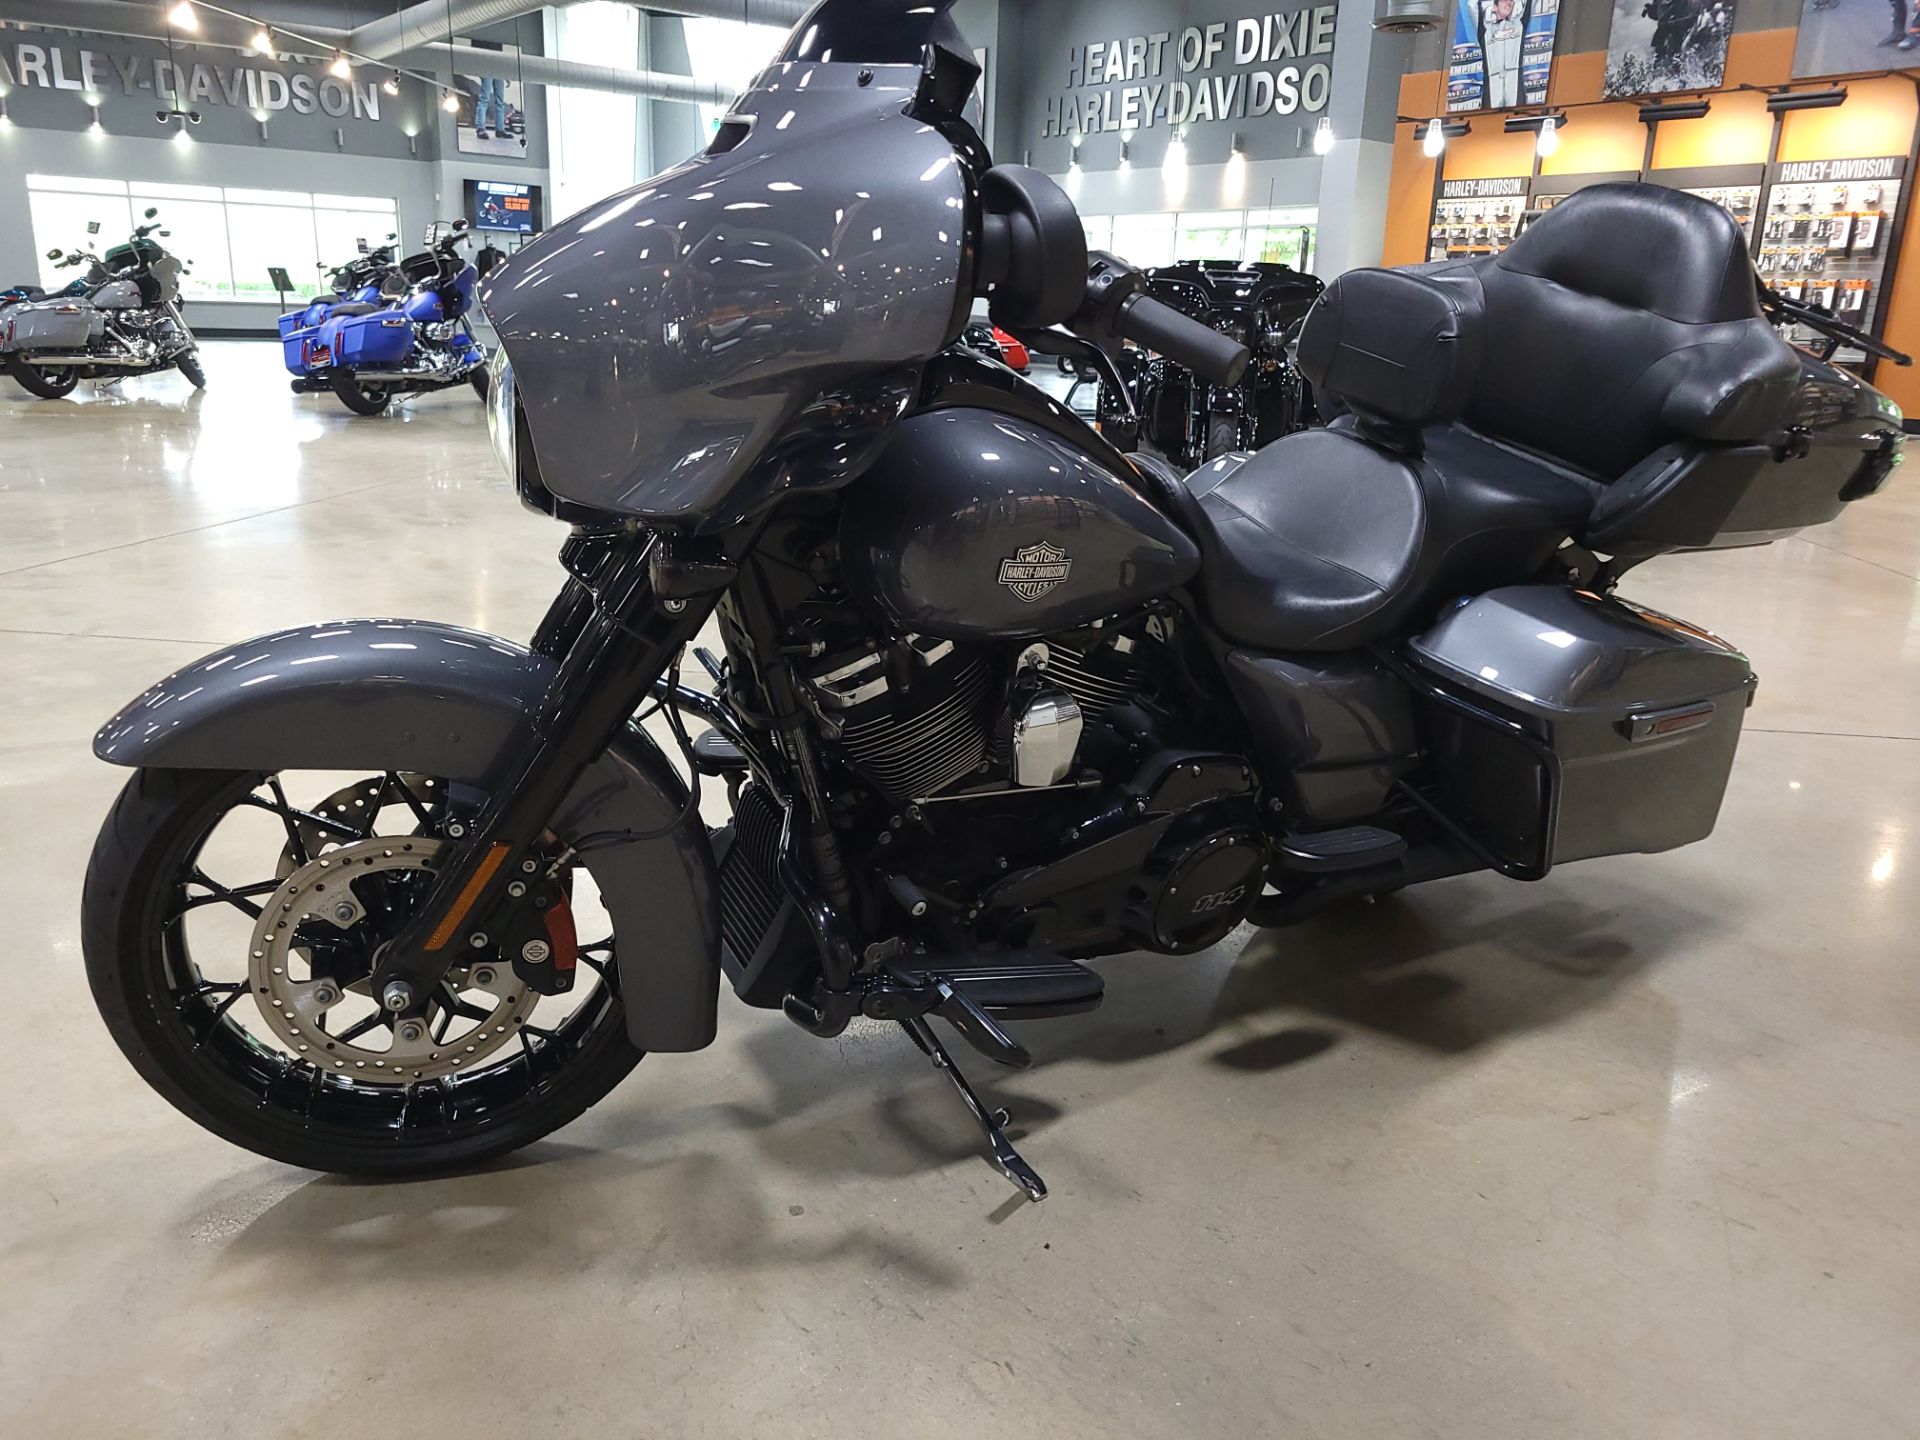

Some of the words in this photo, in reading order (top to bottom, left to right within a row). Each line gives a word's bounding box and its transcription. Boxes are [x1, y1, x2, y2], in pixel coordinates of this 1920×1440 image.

[1065, 32, 1169, 88] HEART
[1179, 22, 1226, 73] OF
[1234, 5, 1337, 65] DIXIE
[1780, 157, 1895, 183] HARLEY-DAVIDSON
[1443, 177, 1522, 198] HARLEY-DAVIDSON
[1025, 549, 1057, 563] MOTOR
[1006, 565, 1066, 579] HARLEY-DAVIDSON
[1018, 581, 1050, 597] CYCLES
[1191, 885, 1246, 913] 114
